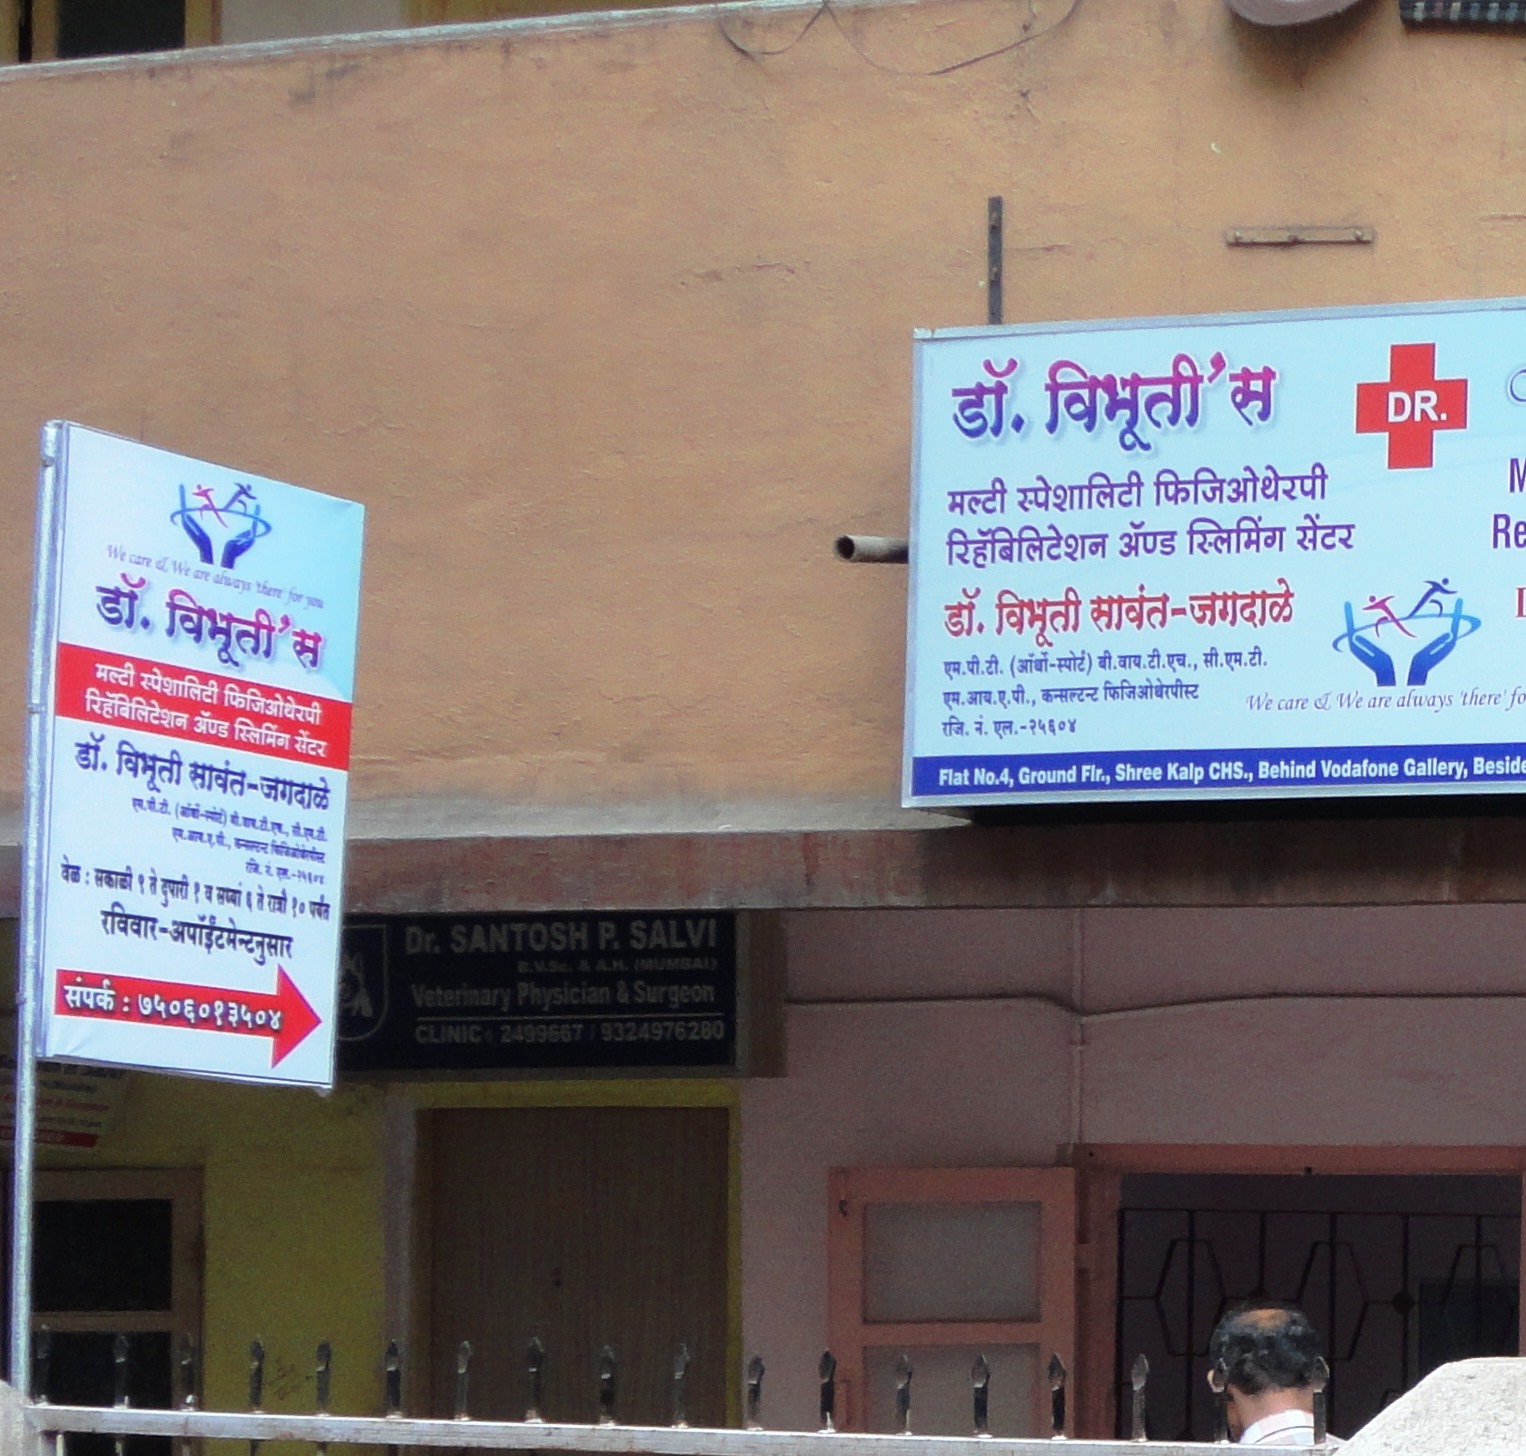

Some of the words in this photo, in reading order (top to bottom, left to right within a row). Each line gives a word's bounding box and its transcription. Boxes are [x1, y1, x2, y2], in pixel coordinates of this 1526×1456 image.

[951, 357, 1025, 439] डॉ.
[1387, 390, 1448, 423] DR.
[947, 476, 1007, 516] मल्टी
[1017, 470, 1144, 514] स्पेशालिटी
[1154, 462, 1328, 506] फिजिओथेरपी
[946, 522, 1108, 568] रिहॅबिलिटेशन
[1188, 515, 1285, 556] स्लिमिंग
[1296, 512, 1356, 553] सेंटर
[106, 545, 125, 561] We
[129, 554, 151, 567] care
[172, 560, 190, 576] We
[194, 569, 210, 581] are
[213, 570, 251, 594] always
[96, 573, 150, 630] डॉ.
[944, 586, 985, 636] डॉ.
[995, 586, 1082, 648] विभूती
[1089, 577, 1295, 631] सावंत-जगदाळे
[943, 654, 1004, 677] एम.पी.टी.
[1203, 647, 1268, 671] सी.एम.टी.
[95, 662, 134, 687] मल्टी
[140, 667, 218, 704] स्पेशालिटी
[224, 685, 322, 724] फिजिओथेरपी
[1245, 693, 1274, 711] We
[1277, 696, 1309, 711] care
[1313, 694, 1332, 711] &
[1336, 691, 1363, 710] We
[1367, 695, 1392, 709] are
[1396, 688, 1453, 713] always
[1460, 687, 1507, 707] 'there'
[294, 729, 327, 757] सेंटर
[941, 715, 969, 738] रजि.
[973, 715, 988, 736] नं.
[75, 731, 108, 771] डॉ.
[116, 740, 183, 792] विभूती
[938, 769, 970, 786] Flat
[973, 768, 1014, 788] No.4,
[1018, 766, 1077, 785] Ground
[1081, 765, 1111, 785] Flr.,
[1115, 764, 1162, 782] Shree
[1167, 762, 1204, 784] Kalp
[1208, 762, 1254, 782] CHS.,
[1258, 761, 1317, 780] Behind
[1321, 758, 1399, 778] Vodafone
[1403, 757, 1468, 780] Gallery,
[94, 864, 133, 892] सकाळी
[149, 868, 157, 895] ते
[160, 873, 189, 907] दुपारी
[405, 926, 441, 956] Dr.
[450, 921, 589, 954] SANTOSH
[598, 921, 620, 951] P.
[629, 918, 718, 950] SALVI
[64, 976, 116, 1012] संपर्क
[411, 984, 511, 1013] Veterinary
[517, 981, 610, 1013] Physician
[617, 980, 629, 1003] &
[633, 979, 715, 1009] Surgeon
[415, 1023, 481, 1044] CLINIC
